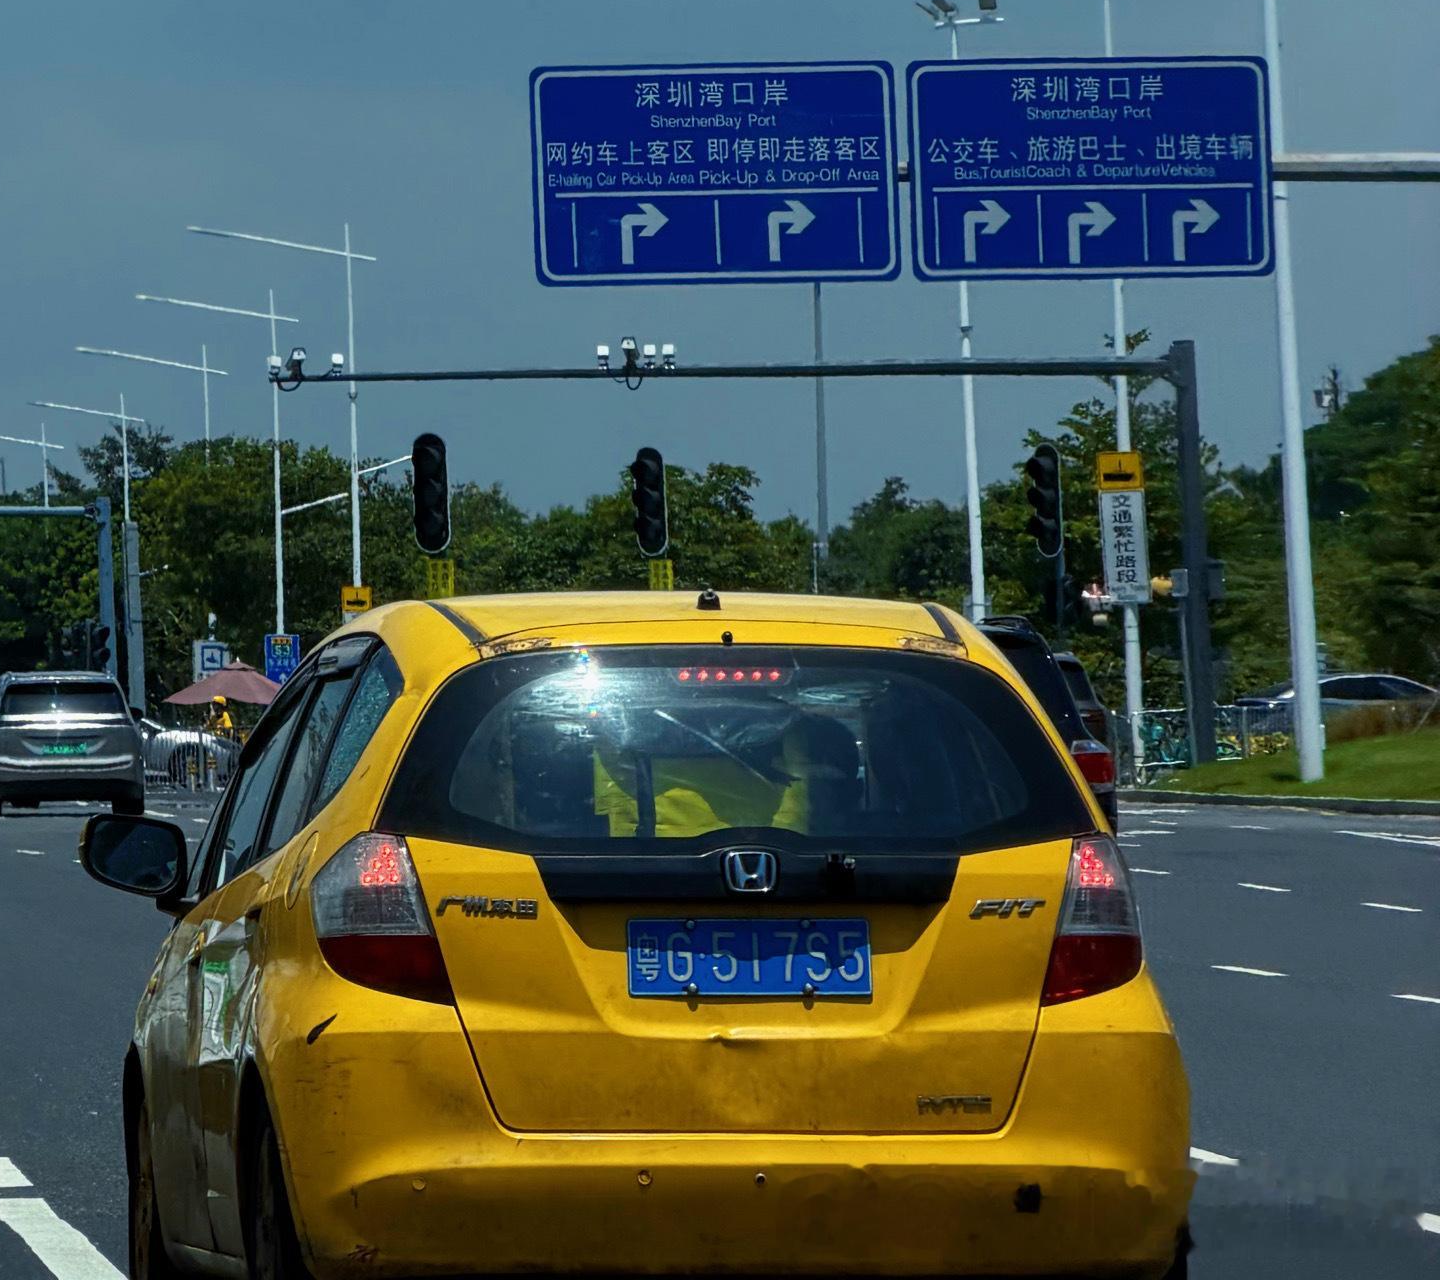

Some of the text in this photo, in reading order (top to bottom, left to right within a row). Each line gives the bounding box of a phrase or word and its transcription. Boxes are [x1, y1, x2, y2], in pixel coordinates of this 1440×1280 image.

[634, 79, 789, 109] 深圳湾口岸
[1010, 75, 1164, 103] 深圳湾口岸
[650, 113, 776, 130] ShenzhenBay Port
[1026, 105, 1152, 121] ShenzhenBay Port
[546, 136, 881, 168] 网约车上客区 即停即走落客区
[596, 172, 617, 186] Car
[621, 171, 663, 186] Pick-Up
[668, 170, 695, 185] Area
[699, 169, 759, 187] Pick-Up
[765, 169, 776, 183] &
[782, 167, 841, 184] Drop-Off
[847, 167, 880, 182] Area
[1076, 164, 1087, 179] &
[1111, 493, 1138, 584] 交通繁忙路段
[968, 898, 1046, 920] FIT
